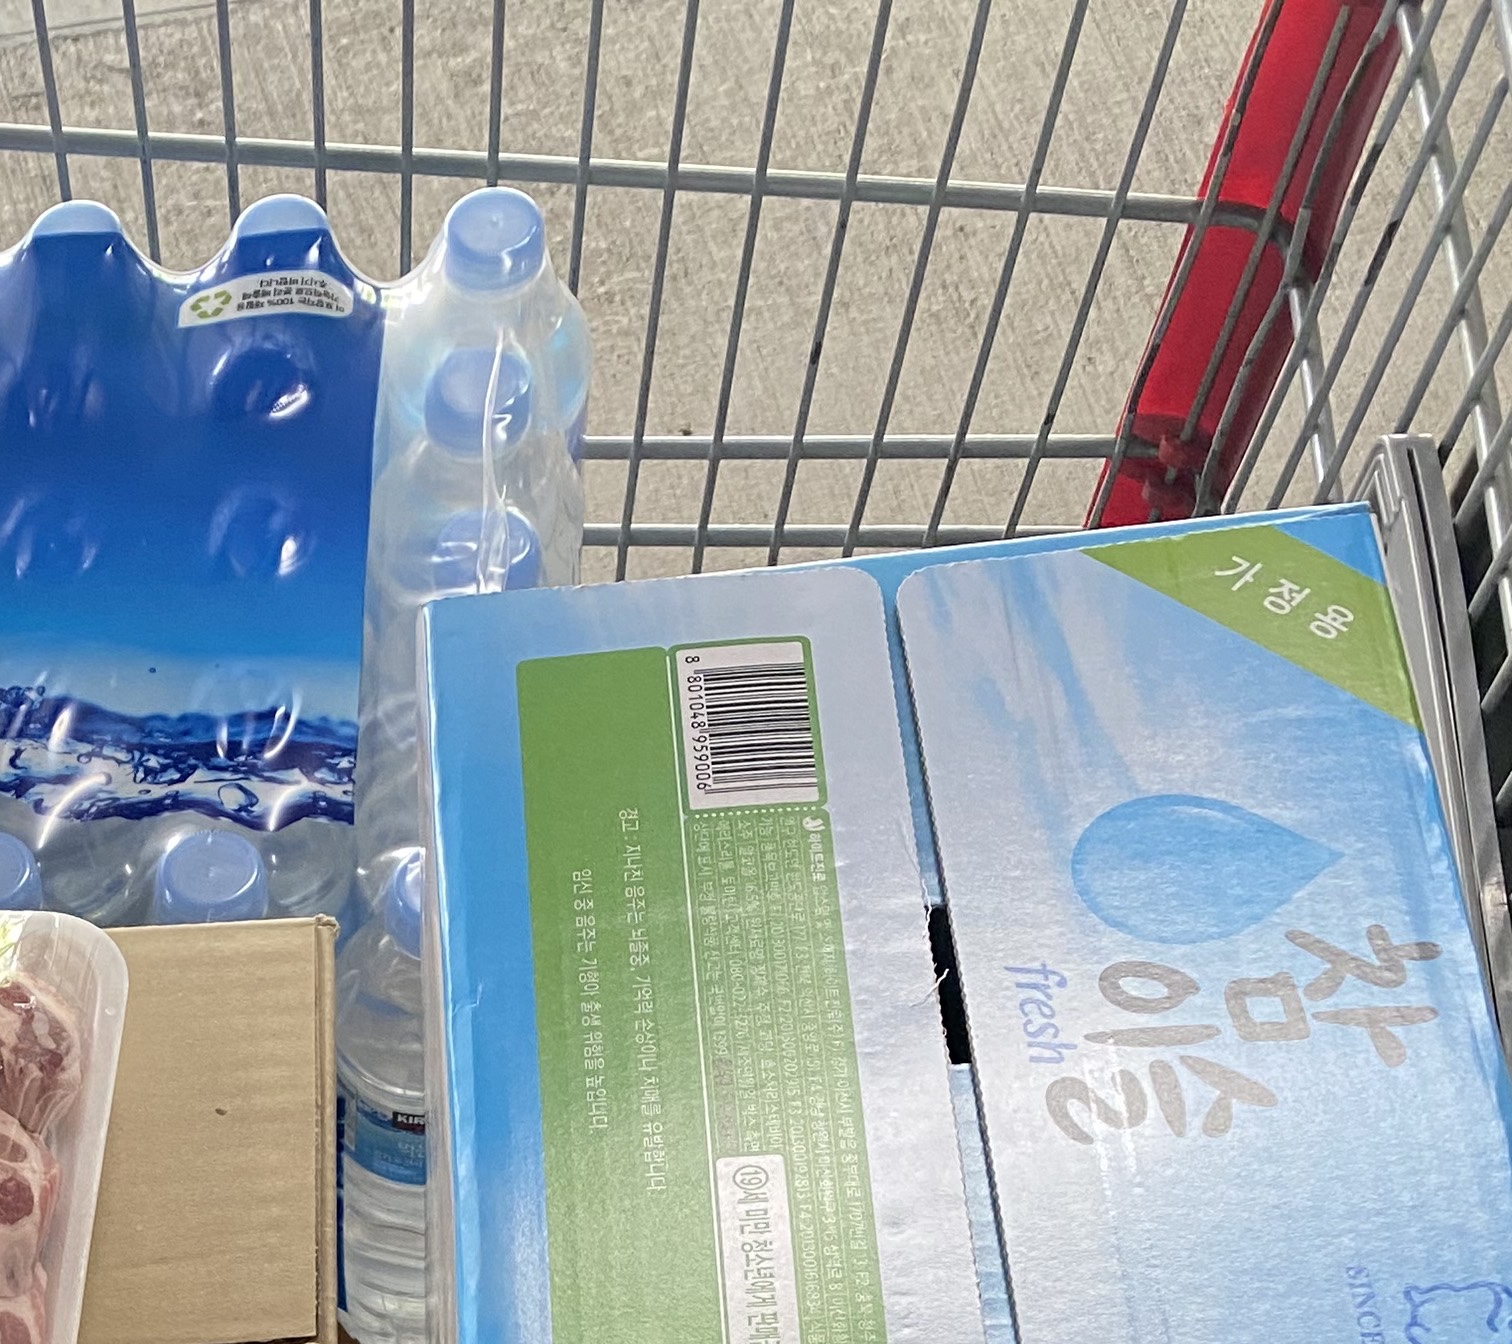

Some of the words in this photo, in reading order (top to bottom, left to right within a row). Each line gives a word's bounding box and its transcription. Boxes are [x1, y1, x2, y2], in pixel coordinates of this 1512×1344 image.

[268, 297, 294, 306] 100%
[685, 655, 699, 663] 8
[686, 675, 705, 729] 801048
[691, 735, 710, 790] 959006
[617, 806, 640, 832] 경고
[621, 844, 643, 882] 지나친
[807, 832, 825, 882] 하이트진로
[571, 868, 593, 894] 임신
[573, 897, 594, 911] 중
[624, 884, 647, 924] 음주는
[574, 913, 598, 953] 음주는
[576, 957, 600, 996] 기형아
[630, 975, 654, 1014] 기억력
[579, 999, 603, 1027] 출생
[1002, 961, 1078, 1064] fresh
[581, 1030, 605, 1071] 위험을
[633, 1017, 659, 1072] 손상이나
[1044, 923, 1443, 1146] 참이슬
[637, 1075, 663, 1117] 치매를
[737, 1207, 771, 1236] 미만
[739, 1238, 779, 1309] 청소년에게
